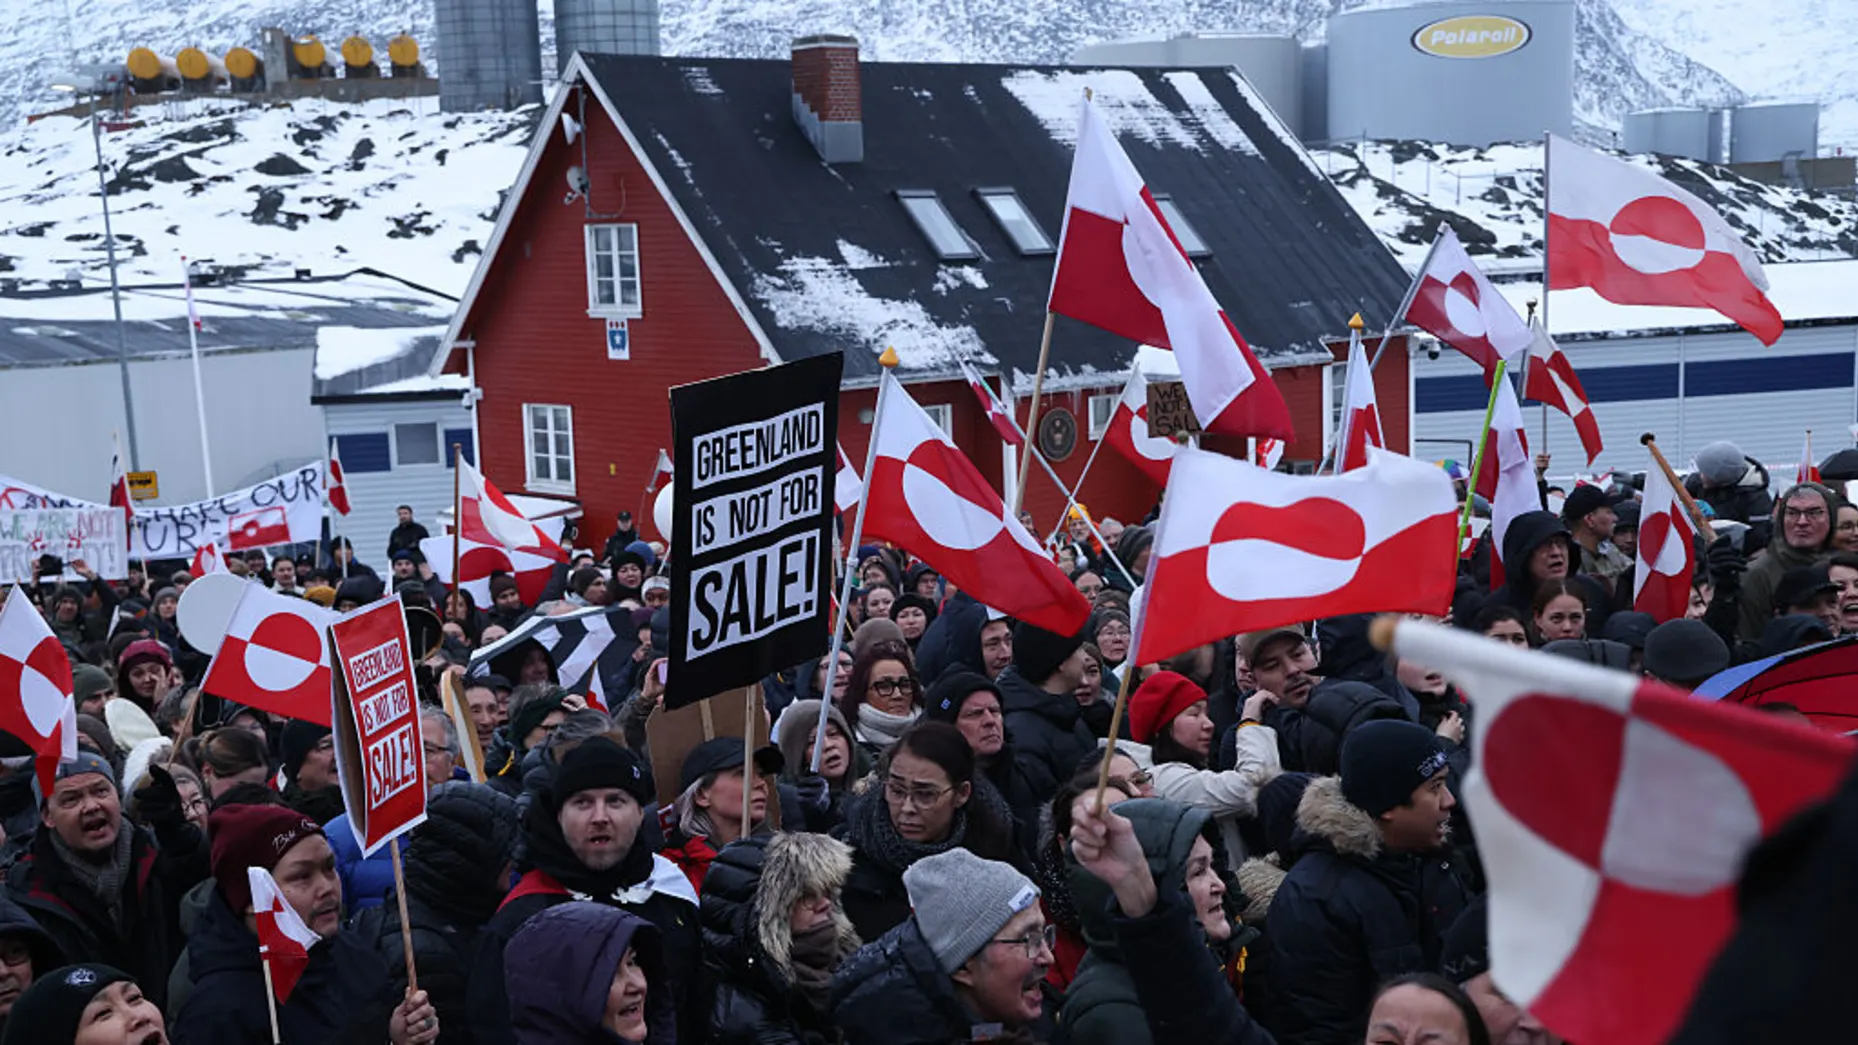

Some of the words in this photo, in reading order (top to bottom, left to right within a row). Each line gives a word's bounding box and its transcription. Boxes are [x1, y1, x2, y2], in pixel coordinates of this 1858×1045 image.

[1431, 27, 1516, 46] Polaroil
[697, 410, 820, 481] GREENLAND
[1155, 414, 1198, 436] SAL
[251, 468, 319, 507] OUR
[36, 511, 74, 541] ARE
[77, 510, 116, 538] NOT
[697, 505, 715, 549] IS
[729, 489, 773, 538] NOT
[780, 474, 818, 520] FOR
[692, 536, 816, 652] SALE!
[352, 643, 403, 687] GREENLAND
[362, 704, 373, 732] IS
[375, 696, 390, 725] NOT
[392, 685, 409, 716] FOR
[371, 728, 416, 804] SALE!
